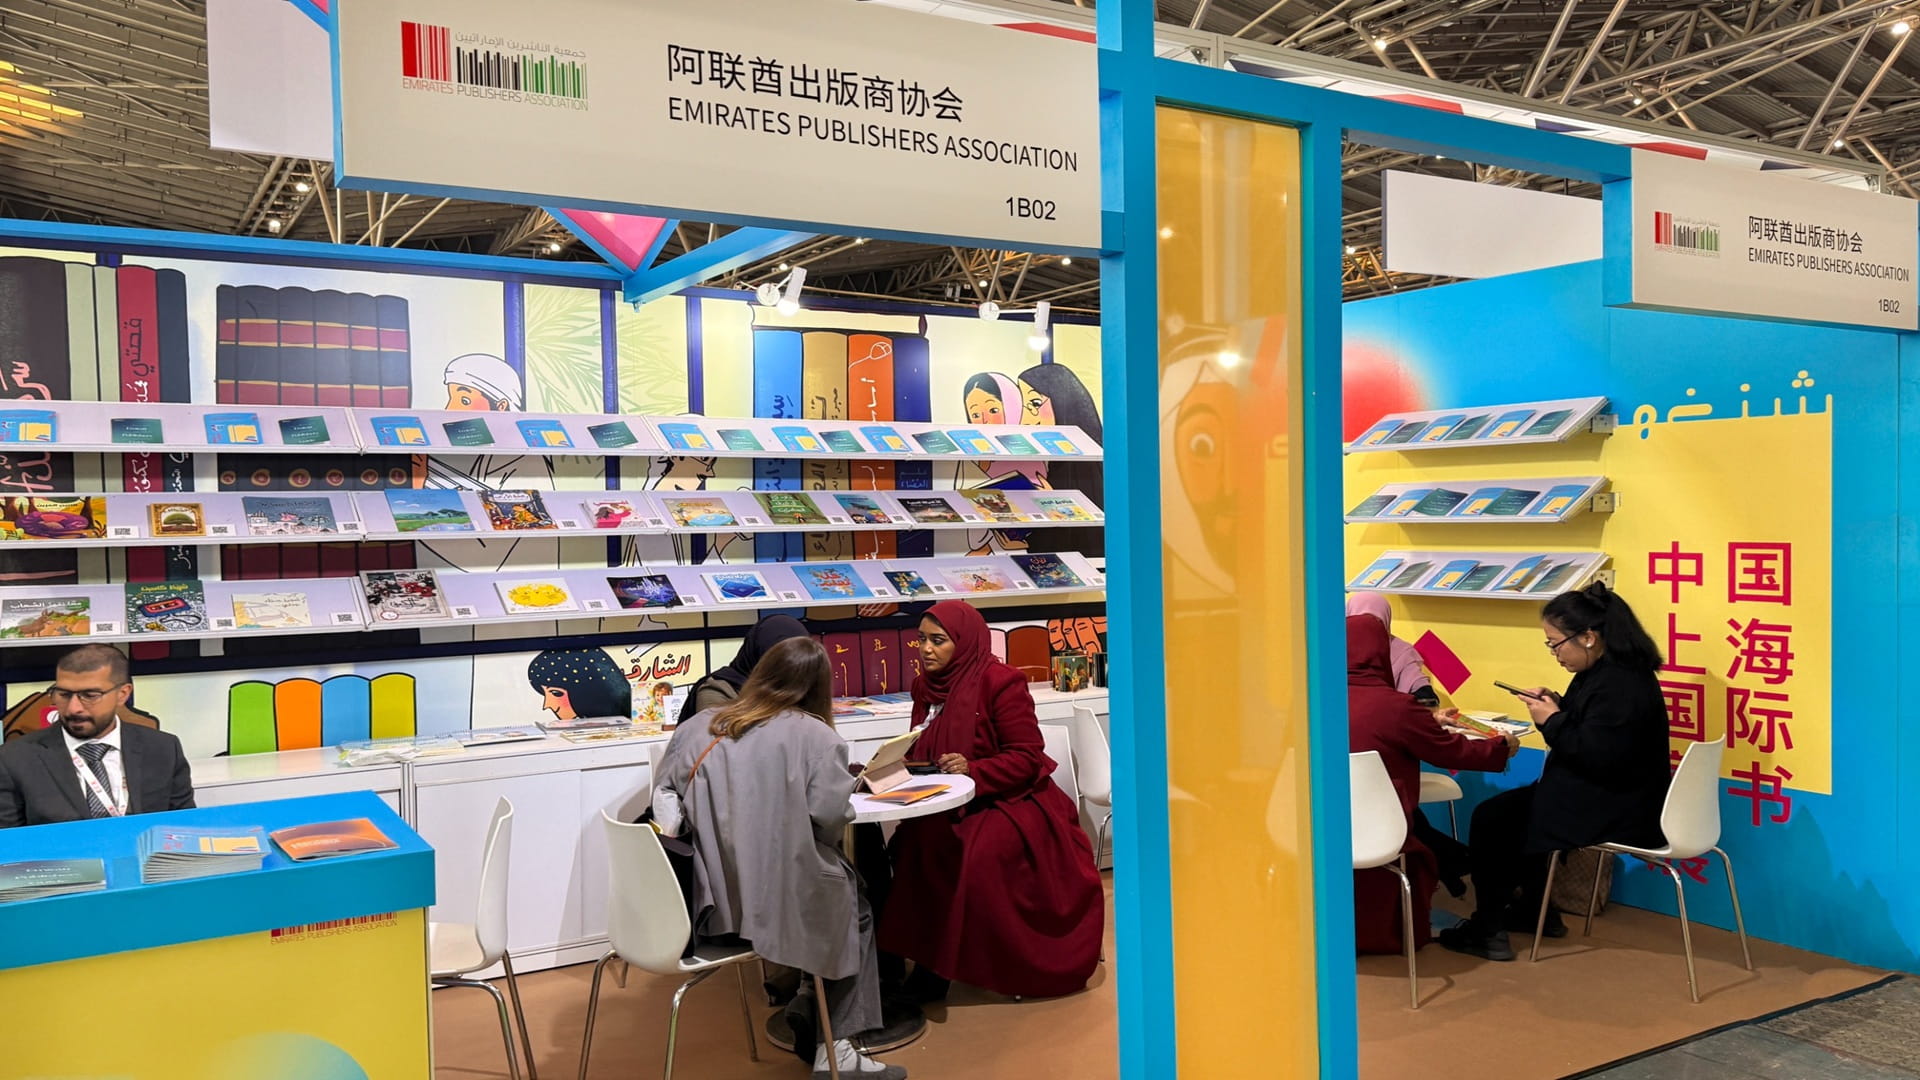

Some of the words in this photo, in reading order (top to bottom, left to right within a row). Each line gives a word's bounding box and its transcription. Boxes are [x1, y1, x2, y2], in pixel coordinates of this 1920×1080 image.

[507, 40, 550, 53] الناشرين
[402, 77, 454, 94] EMIRATES
[457, 85, 522, 103] PUBLISHERS
[524, 93, 589, 111] ASSOCIATION
[668, 44, 963, 123] 阿联酋出版商协会
[669, 97, 791, 135] EMIRATES
[798, 114, 939, 155] PUBLISHERS
[944, 134, 1078, 172] ASSOCIATION
[1006, 197, 1056, 221] 1B02
[1749, 215, 1864, 254] 阿联酋出版商协会
[1749, 247, 1795, 268] EMIRATES
[1797, 254, 1853, 275] PUBLISHERS
[1854, 262, 1909, 282] ASSOCIATION
[1878, 299, 1900, 314] 1B02
[621, 653, 692, 682] الشارق
